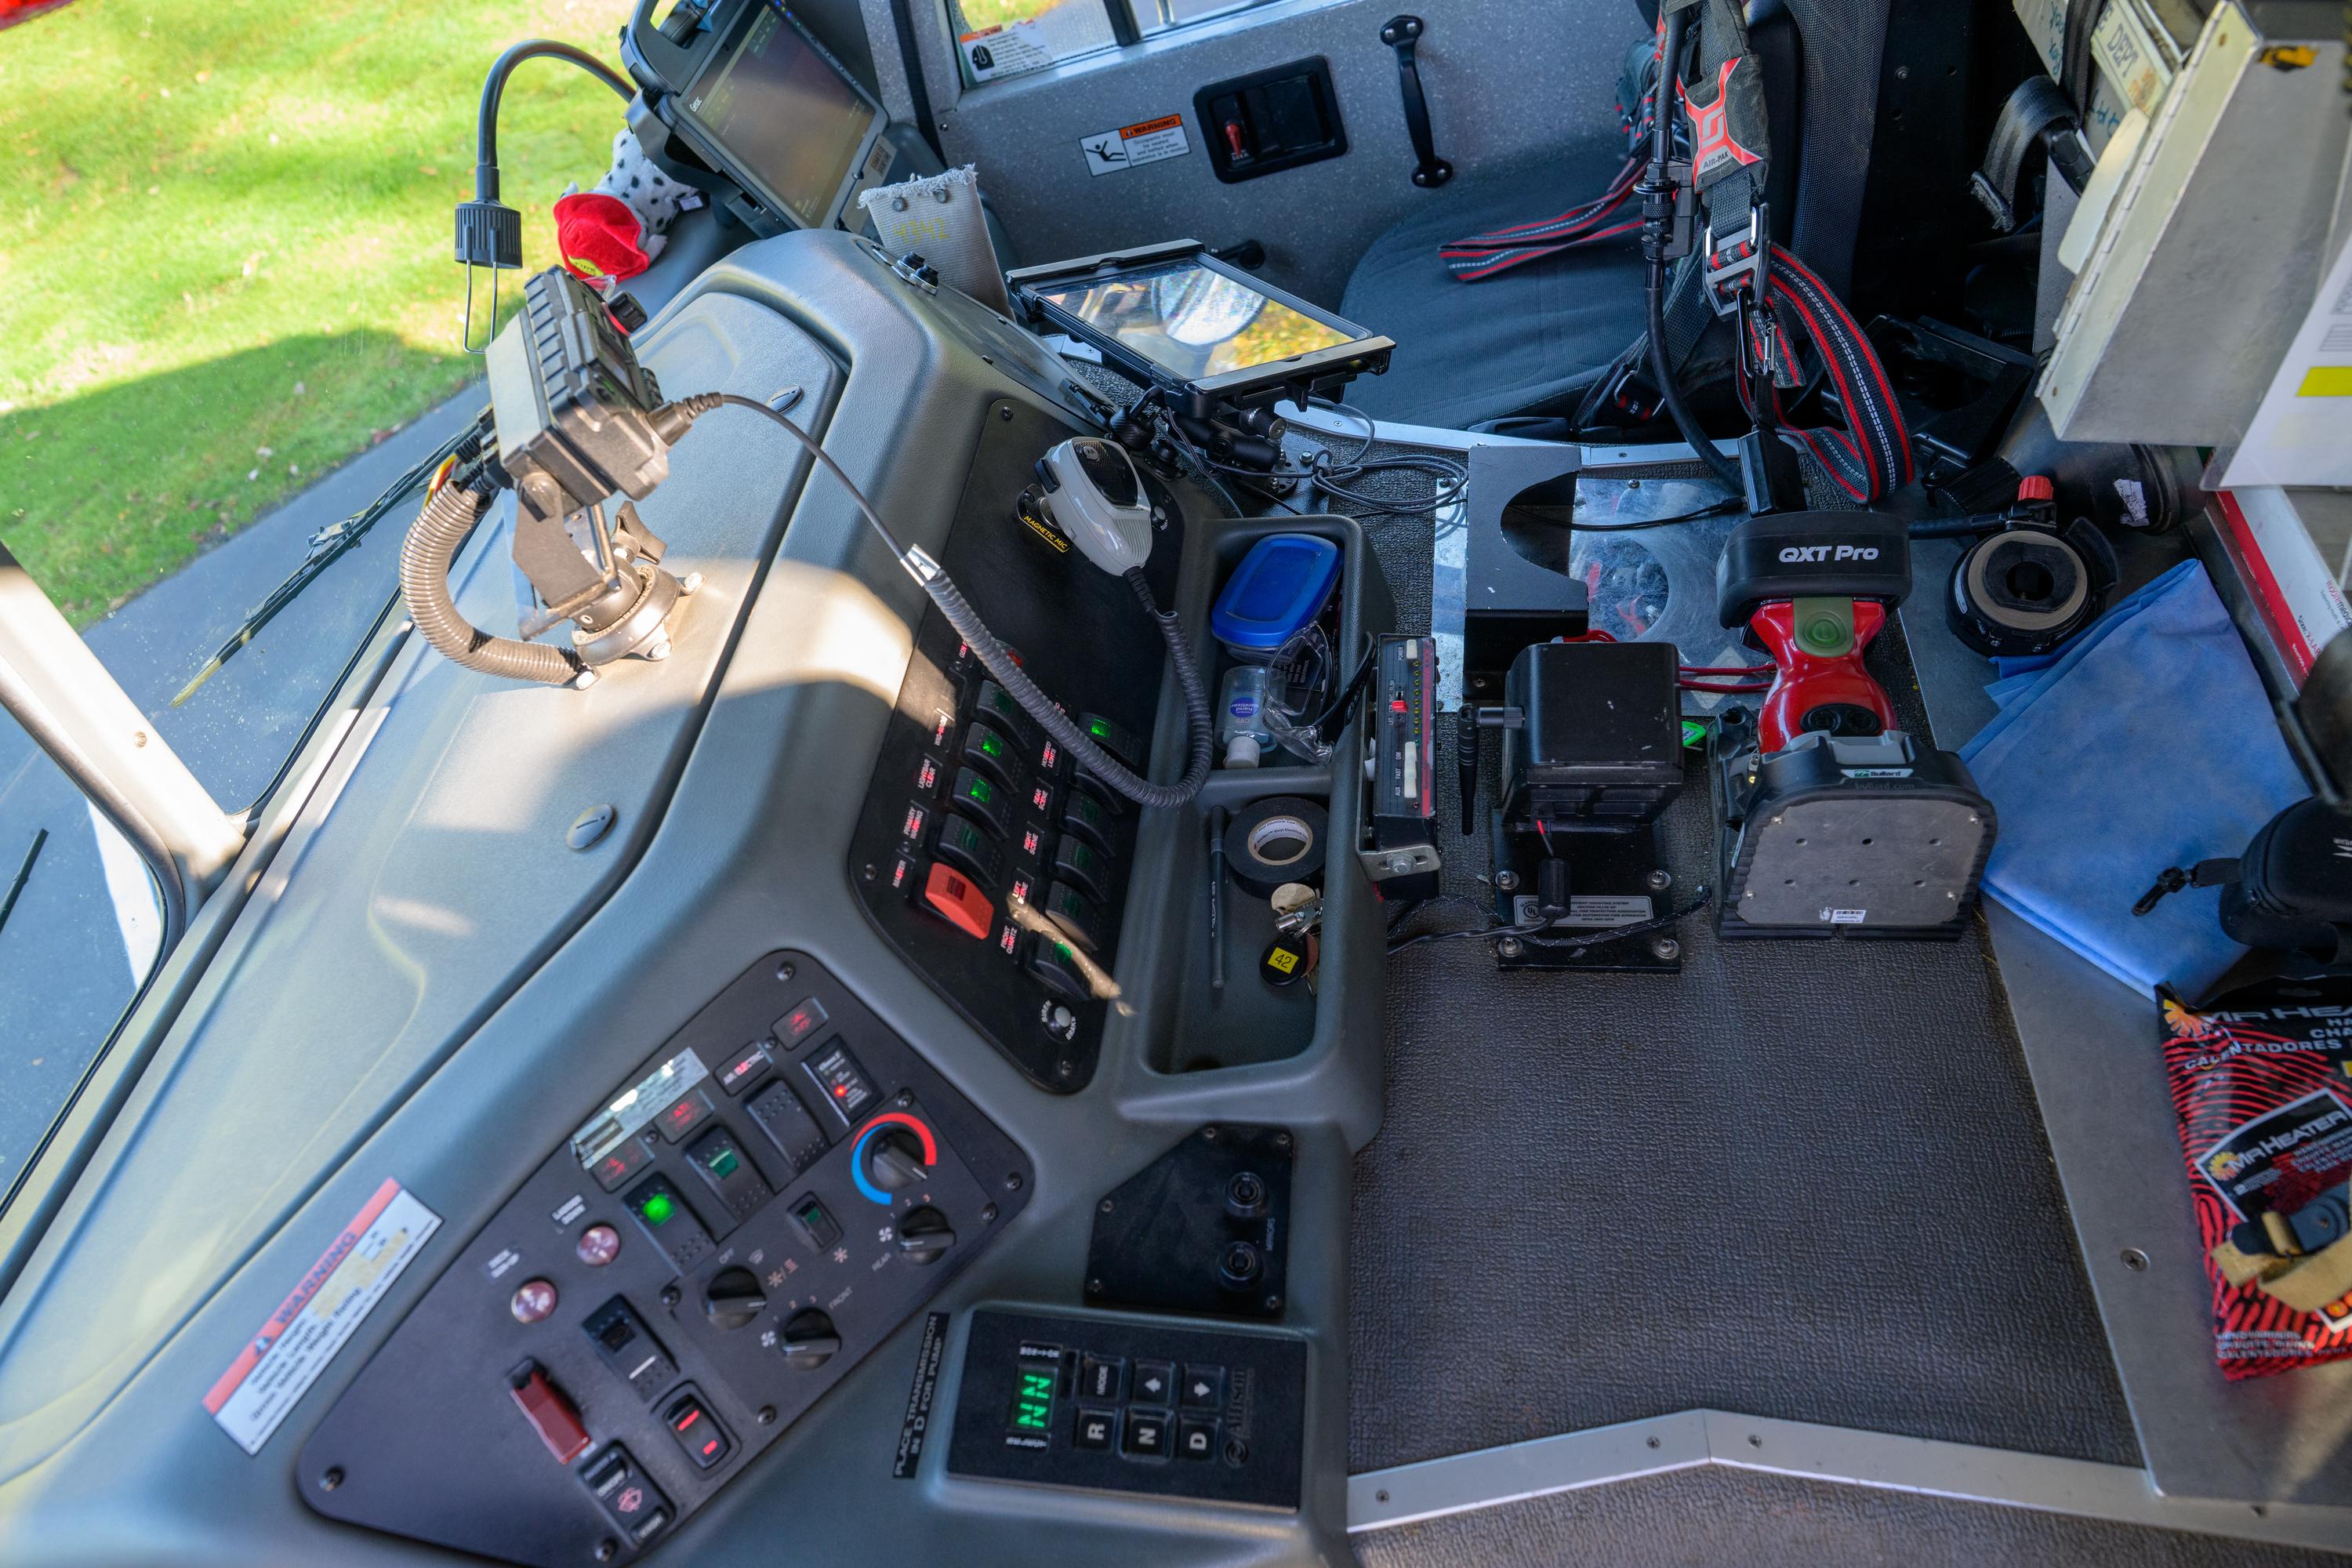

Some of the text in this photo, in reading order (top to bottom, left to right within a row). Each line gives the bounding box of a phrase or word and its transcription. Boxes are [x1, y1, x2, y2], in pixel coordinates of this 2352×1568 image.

[1134, 118, 1176, 134] WARNING
[1703, 151, 1729, 169] AIR-PAK
[892, 217, 950, 245] 4342
[1023, 515, 1068, 549] MAGNETIC MIC
[1779, 545, 1879, 562] QXT Pro
[1041, 742, 1051, 768] HOSEBED
[918, 758, 931, 789] LIGHTBAR
[925, 767, 936, 788] CLEAR
[1033, 789, 1042, 805] REAR
[1038, 790, 1047, 811] SCENE
[903, 807, 916, 836] PRIMARY
[1023, 830, 1032, 851] RIGHT
[1029, 833, 1039, 855] SCENE
[892, 860, 906, 888] MASTER
[1012, 880, 1022, 898] LEFT
[1018, 881, 1029, 905] SCENE
[1000, 925, 1010, 949] FRONT
[1007, 927, 1018, 955] QUARTZ
[1275, 953, 1292, 969] 42
[1041, 1000, 1051, 1022] SIREN
[1065, 1016, 1076, 1040] BRAKE
[2184, 1039, 2343, 1069] CALENTADORES
[872, 1252, 891, 1272] REAR
[276, 1231, 357, 1325] WARNING
[828, 1286, 852, 1310] FRONT
[1096, 1365, 1109, 1396] MODE
[895, 1316, 938, 1476] PLACE TRANSMISSION
[910, 1337, 942, 1454] IN D FOR PUMP
[1087, 1422, 1207, 1450] R N D
